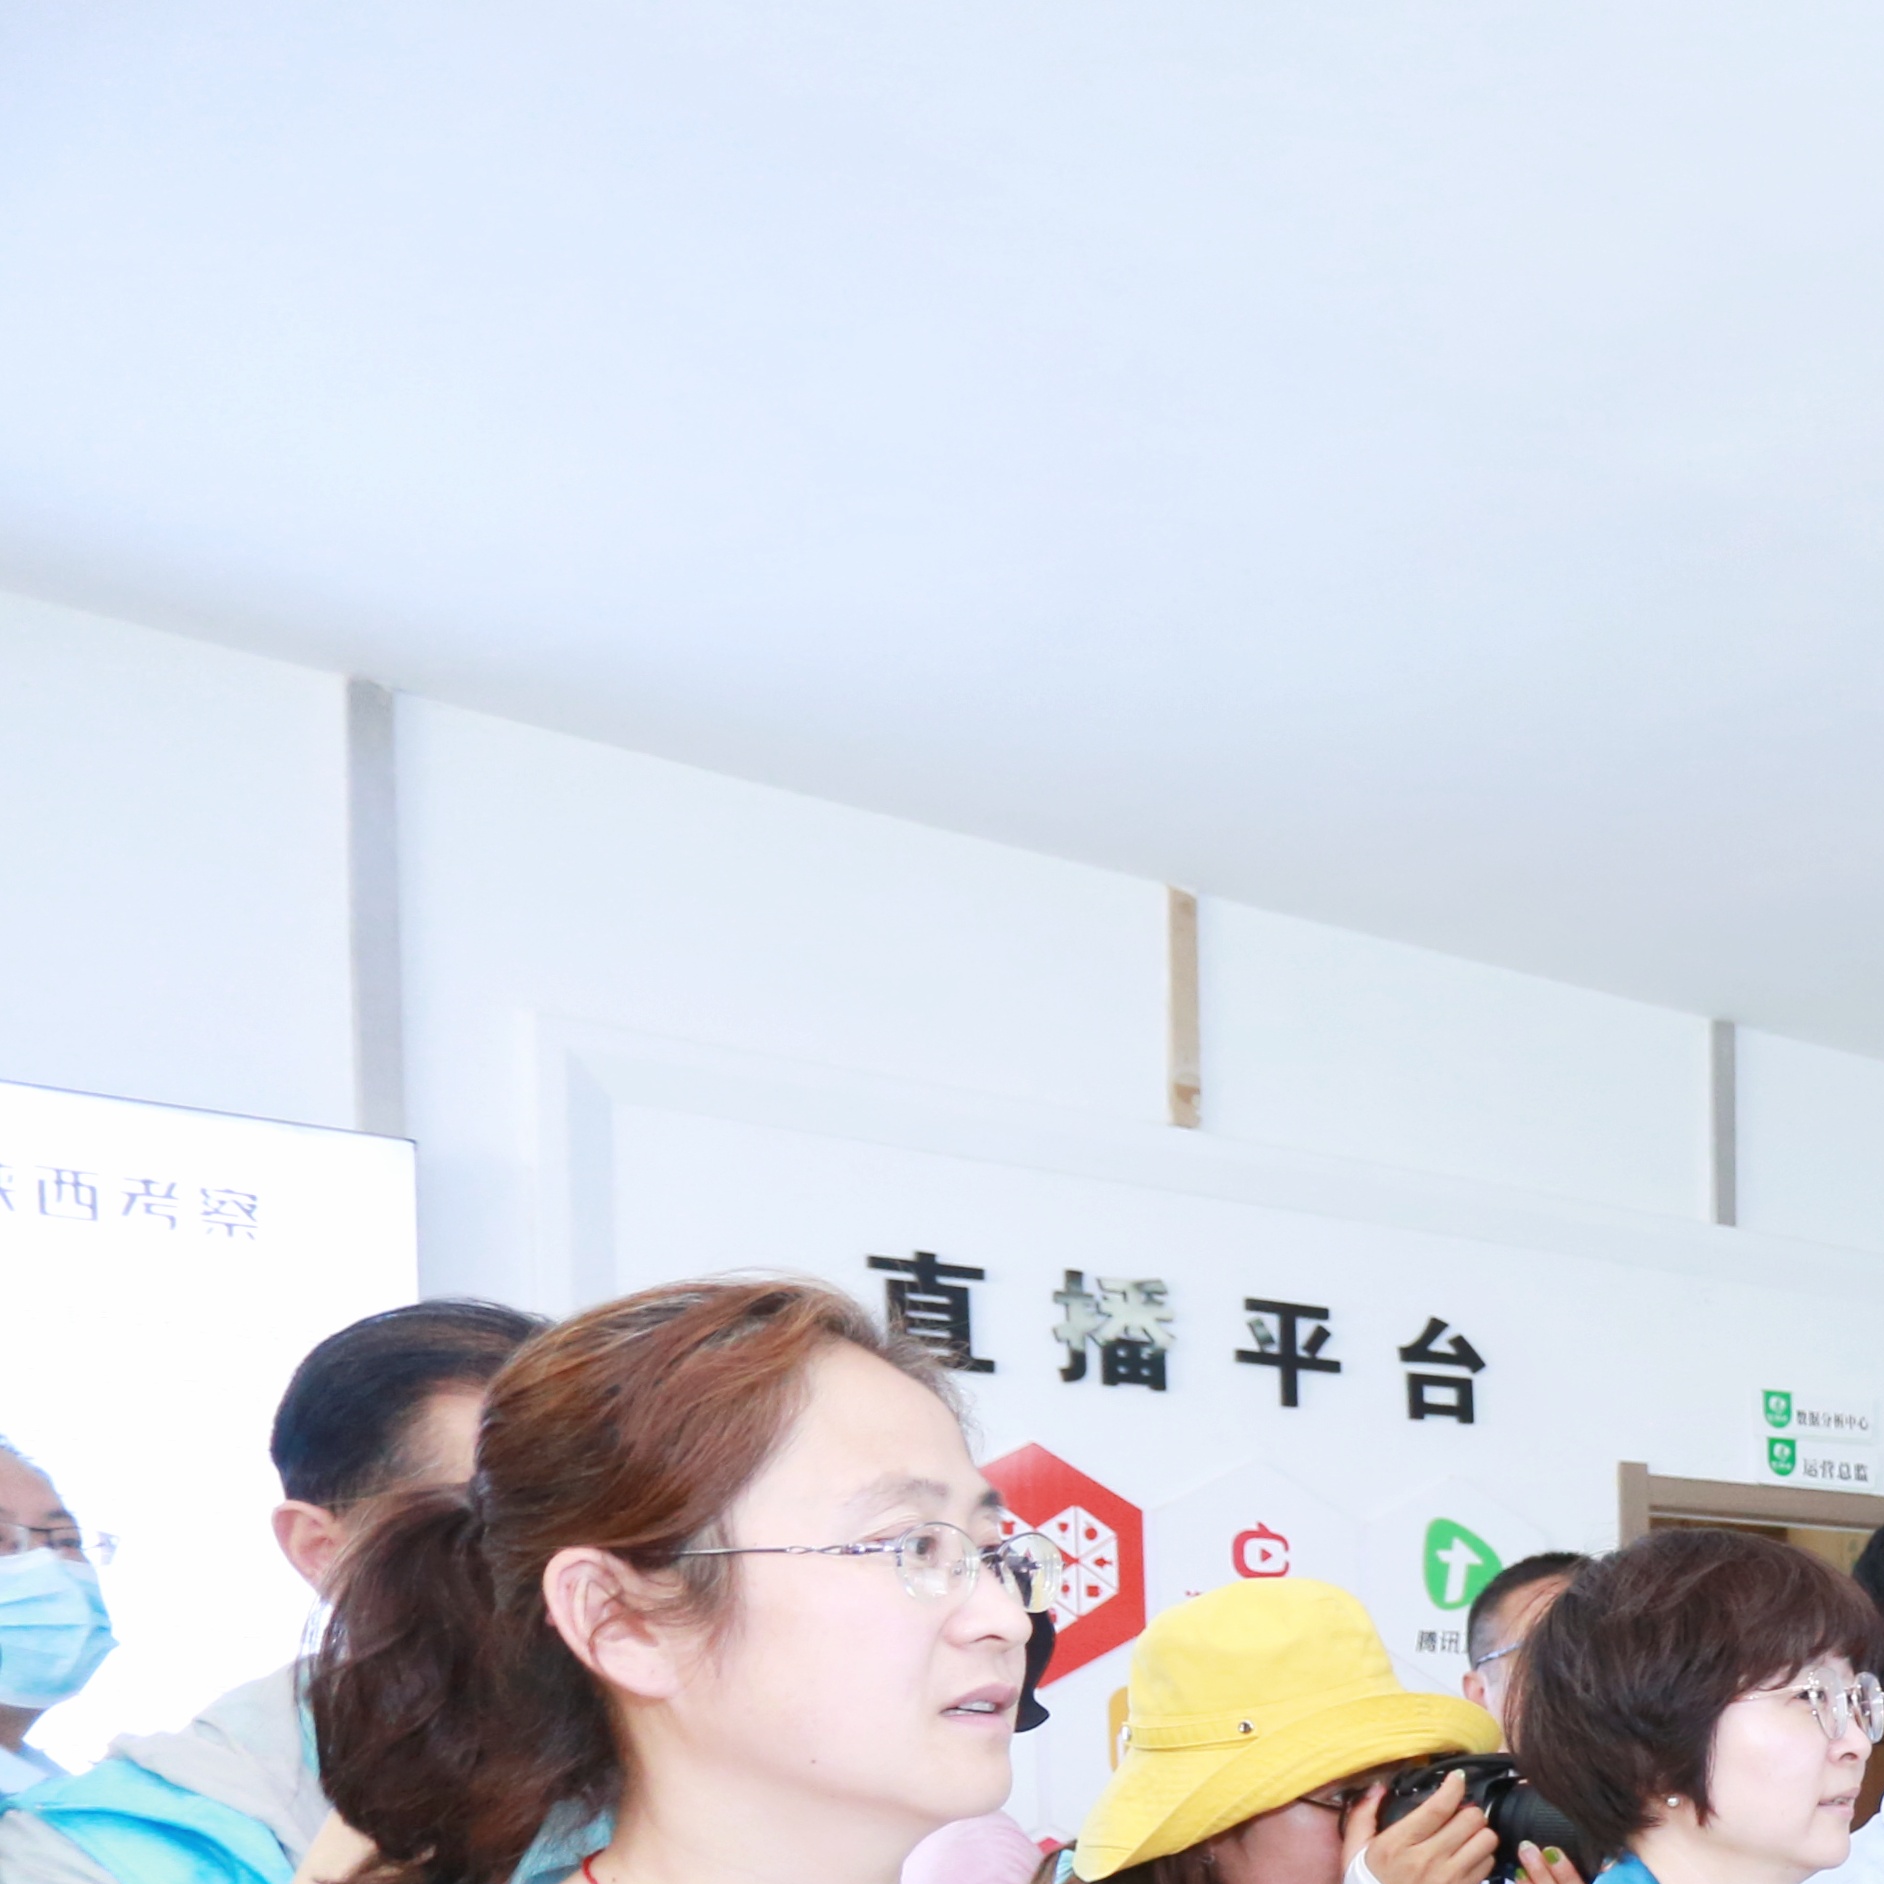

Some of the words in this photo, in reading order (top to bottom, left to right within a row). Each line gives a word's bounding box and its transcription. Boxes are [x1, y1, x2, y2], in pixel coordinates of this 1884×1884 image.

[0, 1163, 258, 1240] 西考察
[867, 1251, 1486, 1424] 直播平台
[1416, 1629, 1468, 1654] 腾讯
